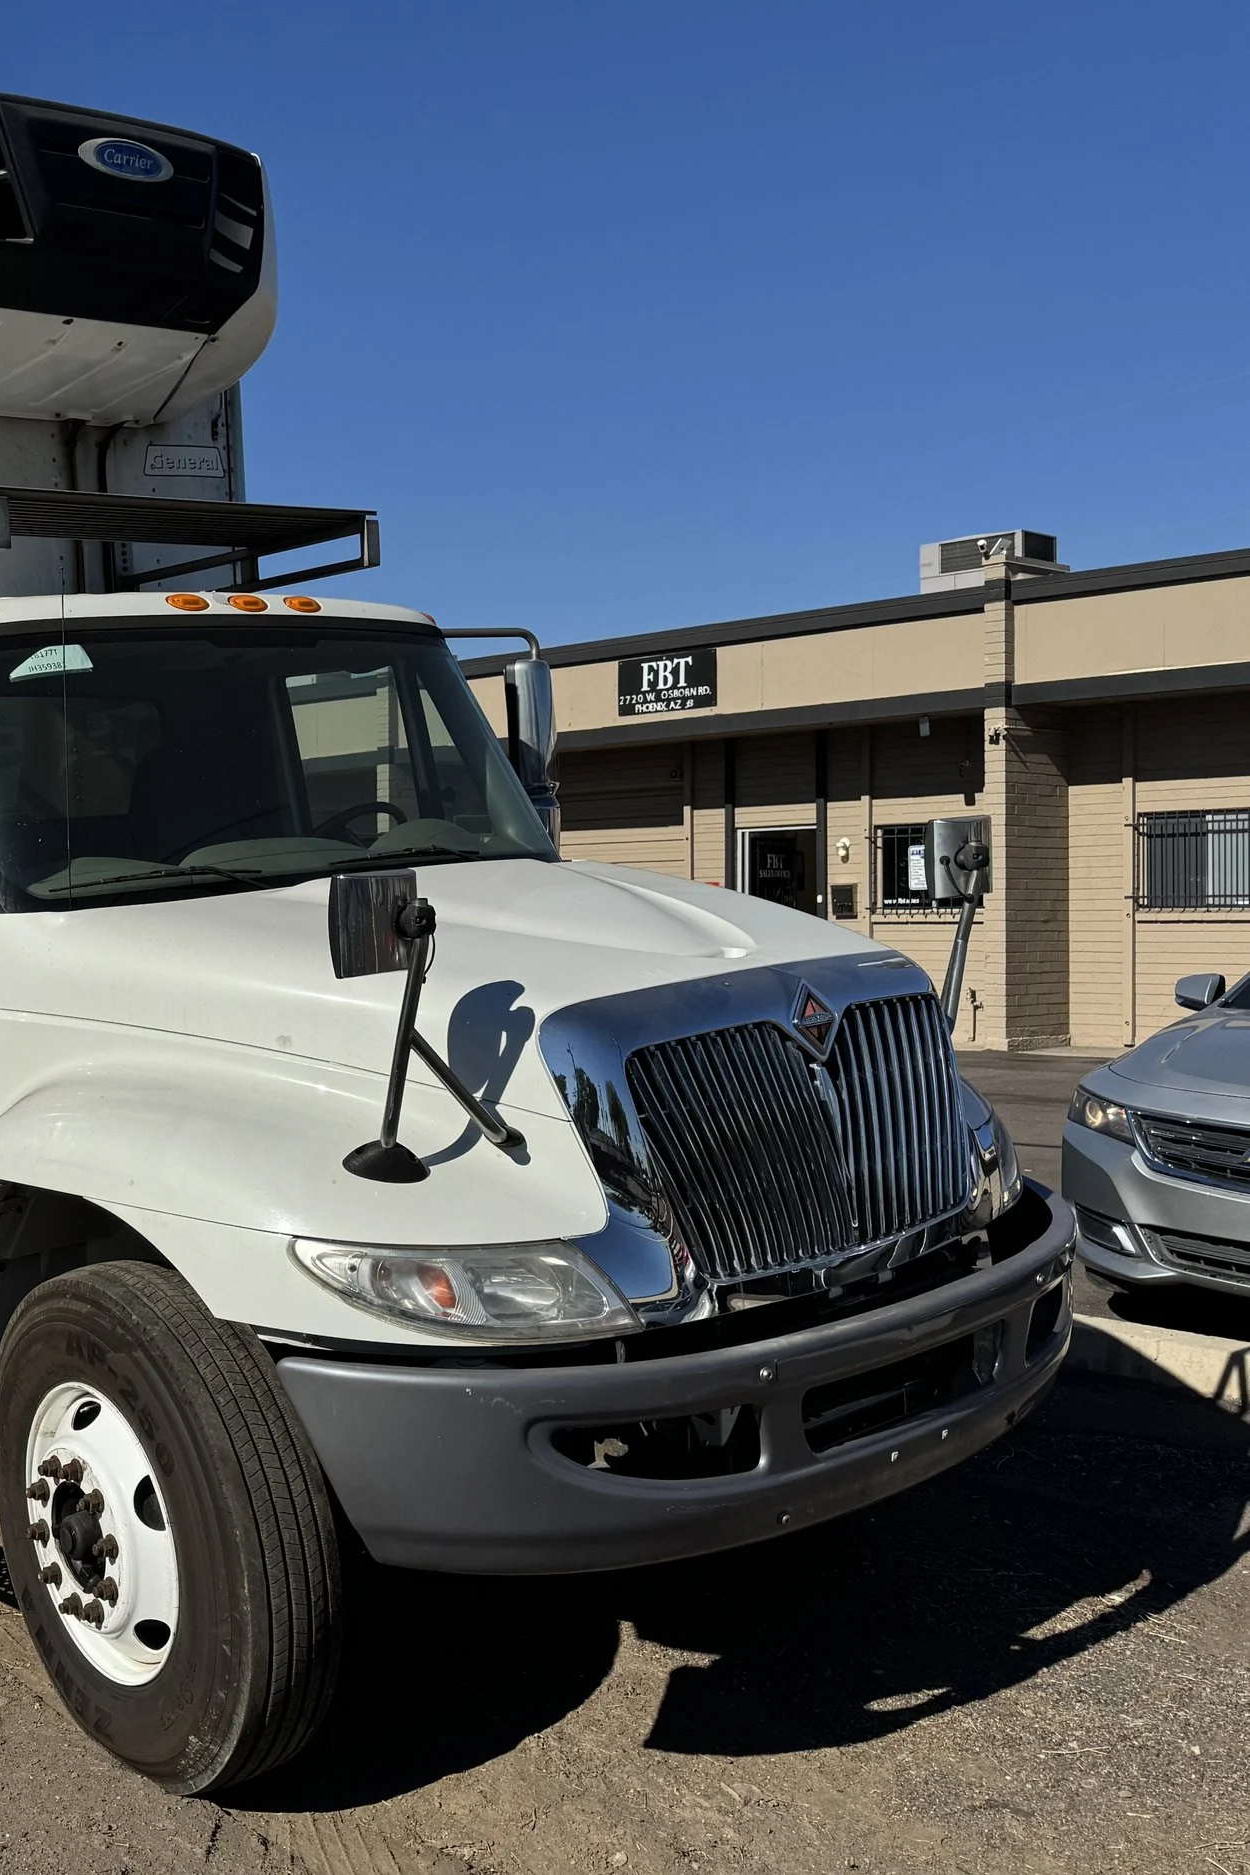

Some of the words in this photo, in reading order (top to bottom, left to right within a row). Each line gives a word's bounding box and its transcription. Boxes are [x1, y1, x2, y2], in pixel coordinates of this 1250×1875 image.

[104, 148, 153, 170] Carrier
[150, 453, 219, 471] General
[640, 656, 693, 691] FBT
[619, 694, 643, 705] 2720
[661, 686, 697, 700] OSBORN
[697, 685, 712, 696] RD.
[669, 700, 682, 710] AZ
